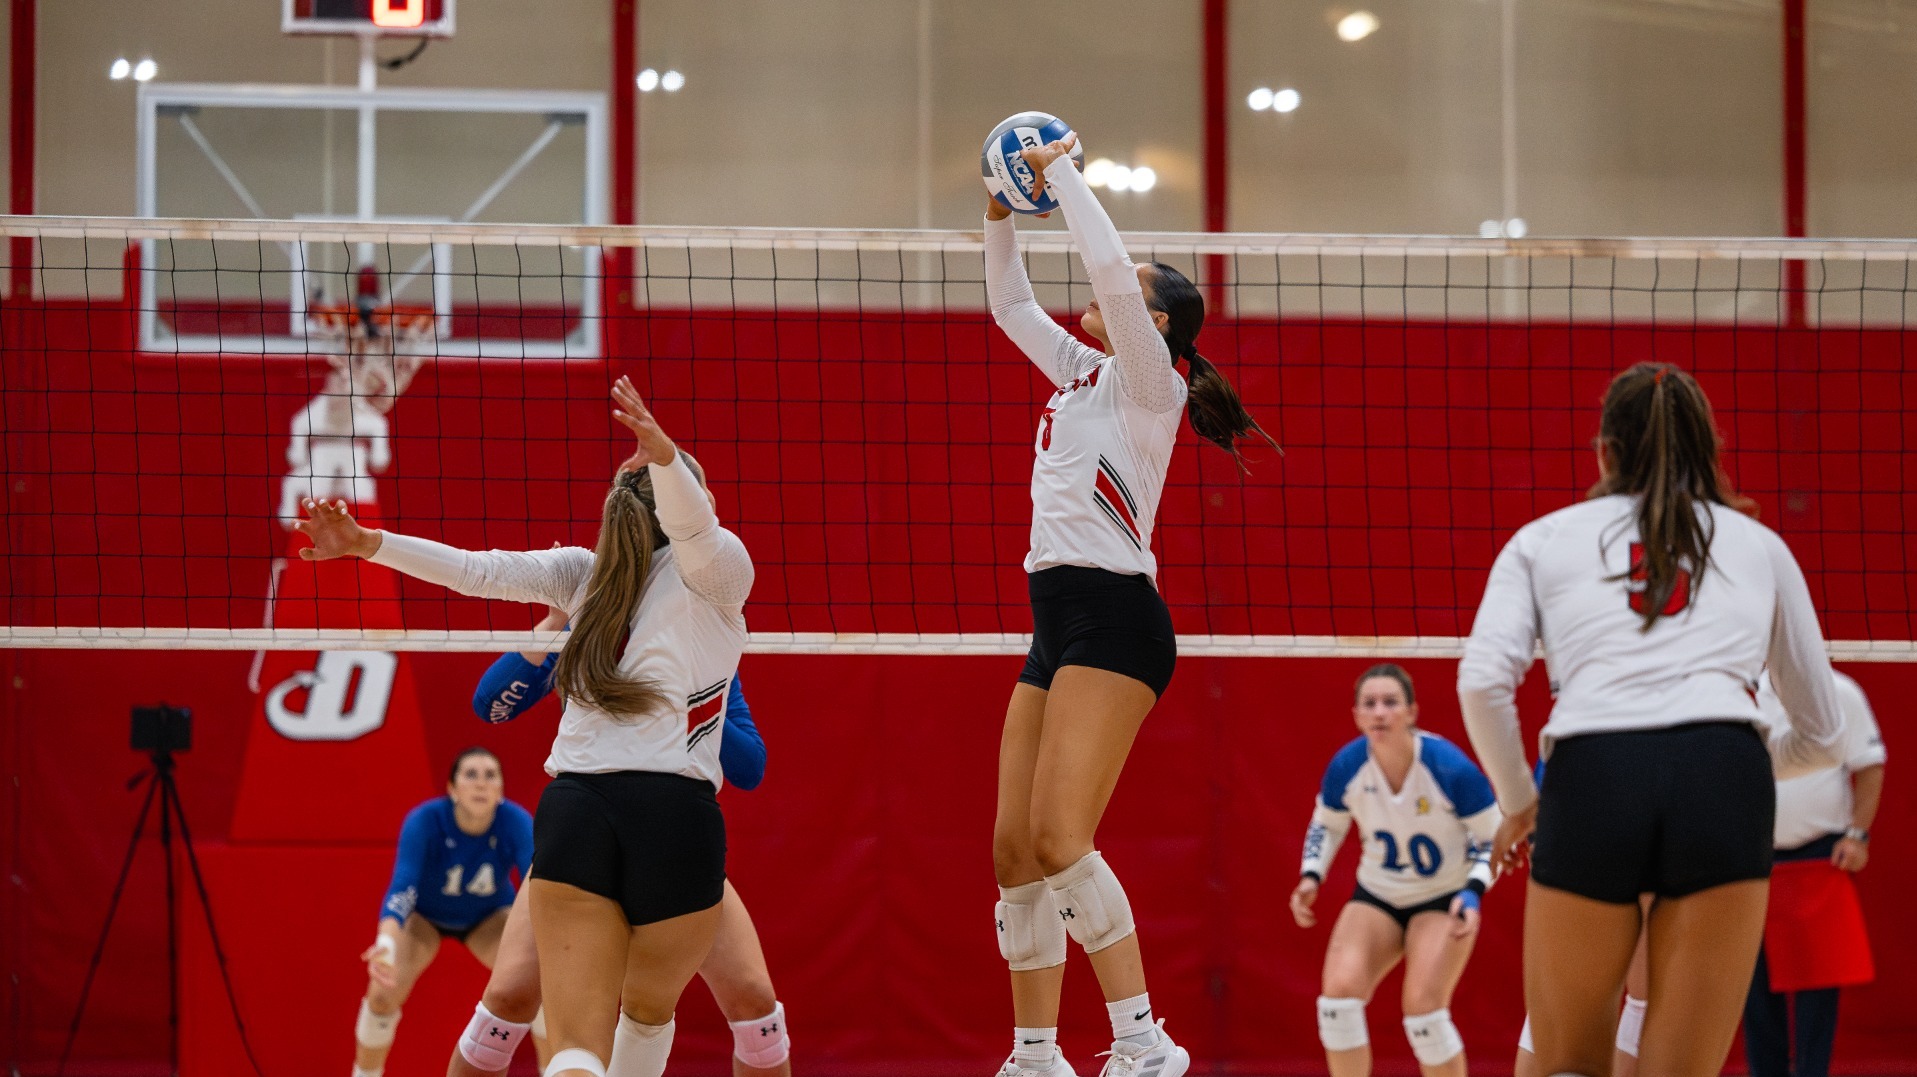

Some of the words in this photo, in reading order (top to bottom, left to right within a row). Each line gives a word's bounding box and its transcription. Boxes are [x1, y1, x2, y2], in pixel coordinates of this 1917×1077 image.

[1006, 150, 1034, 194] NCAA
[1374, 828, 1443, 878] 20
[441, 863, 497, 896] 14
